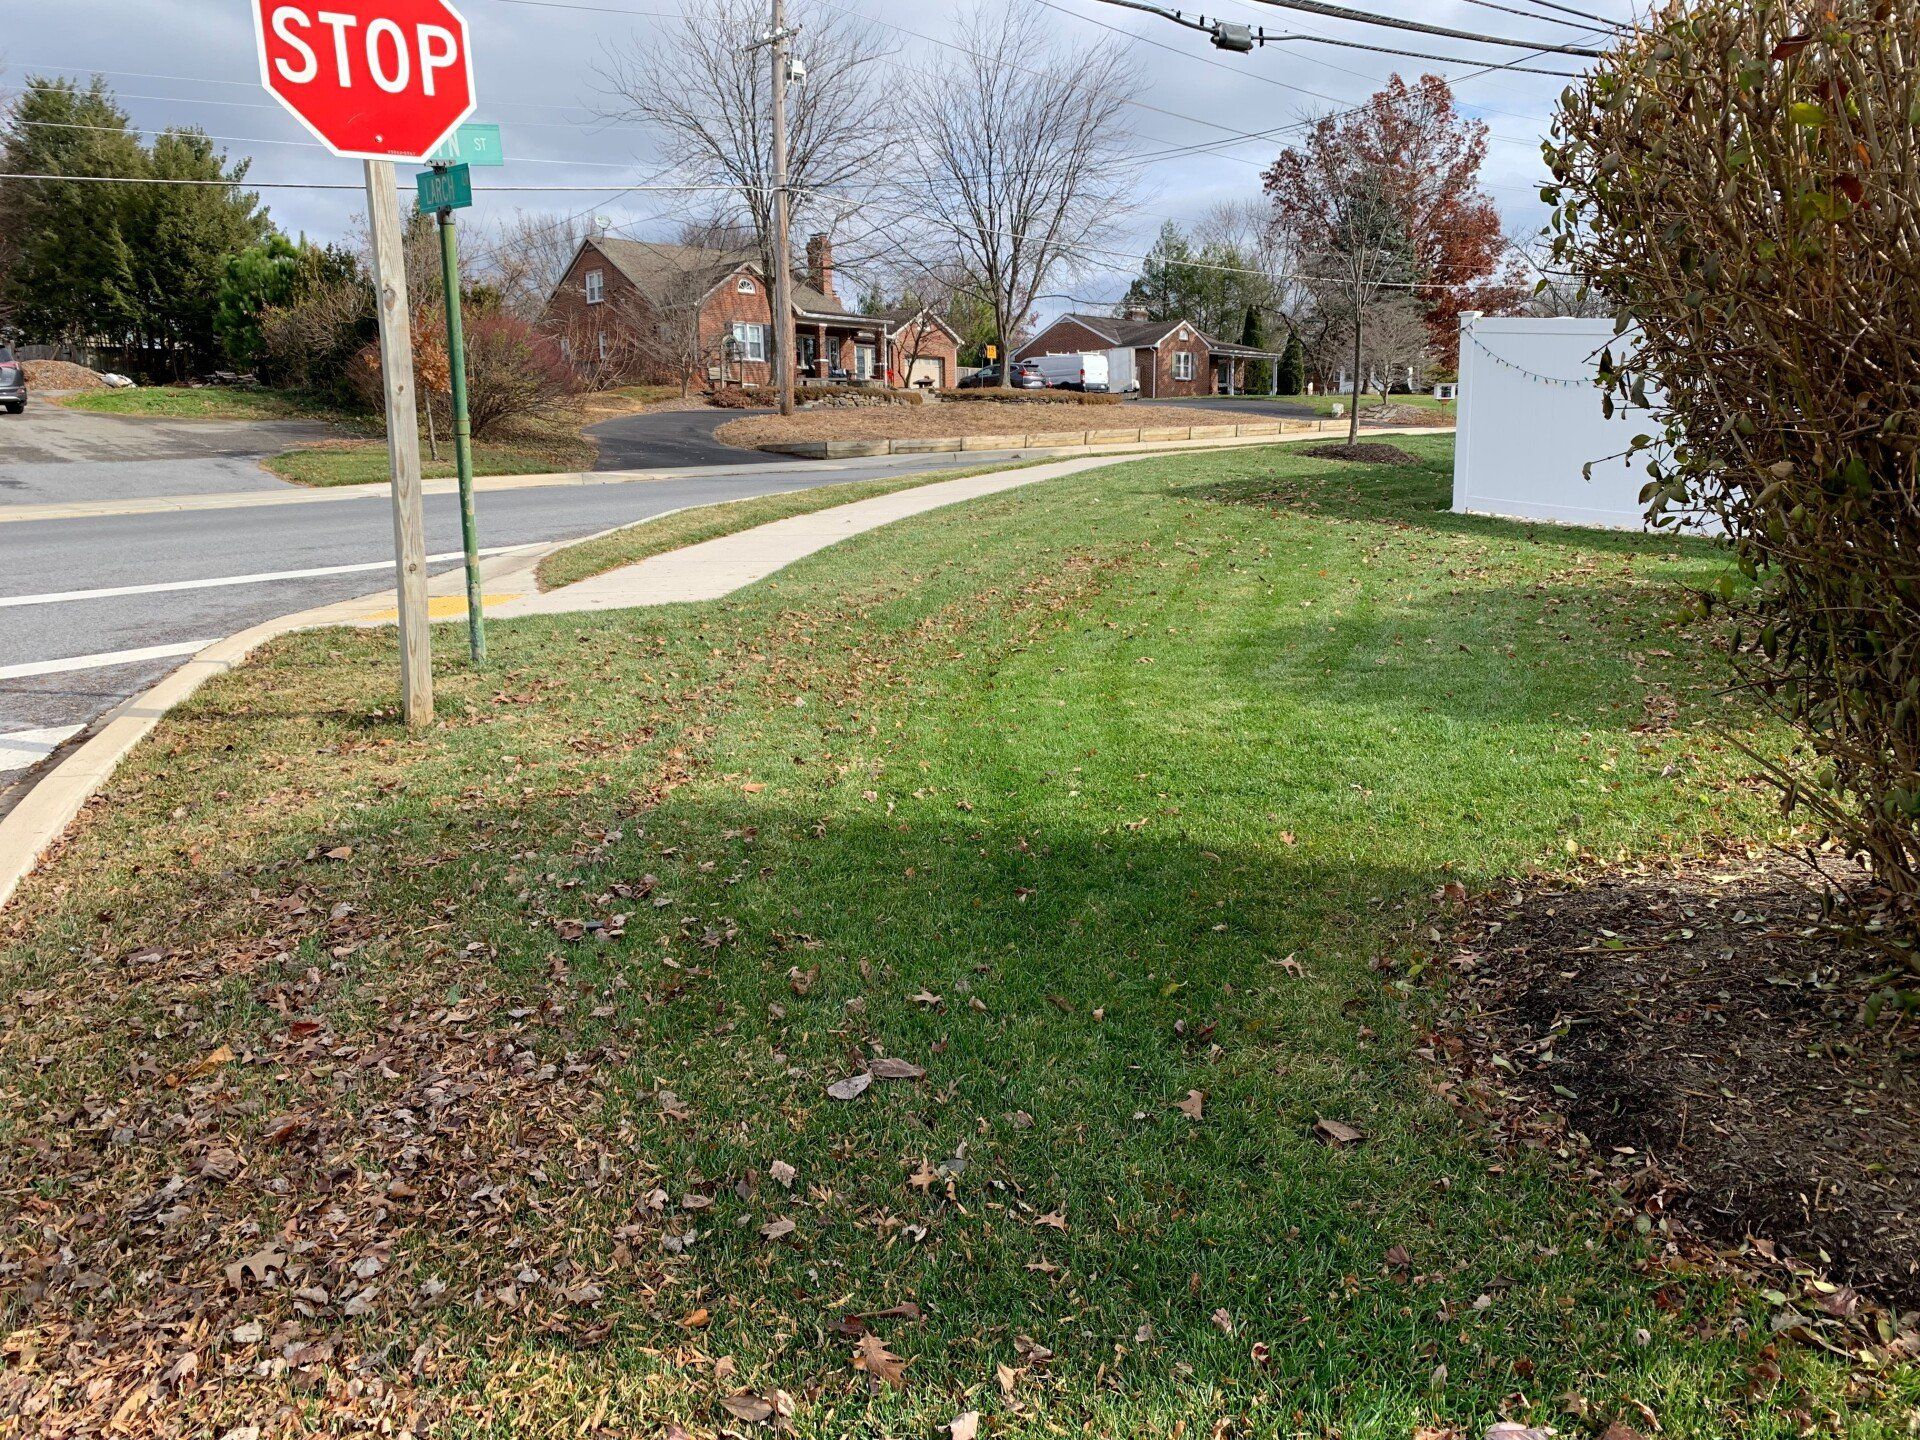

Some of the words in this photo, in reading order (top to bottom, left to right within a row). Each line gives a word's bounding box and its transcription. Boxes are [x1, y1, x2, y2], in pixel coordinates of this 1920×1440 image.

[272, 6, 458, 96] STOP
[473, 137, 486, 151] ST
[424, 174, 455, 205] LARCH
